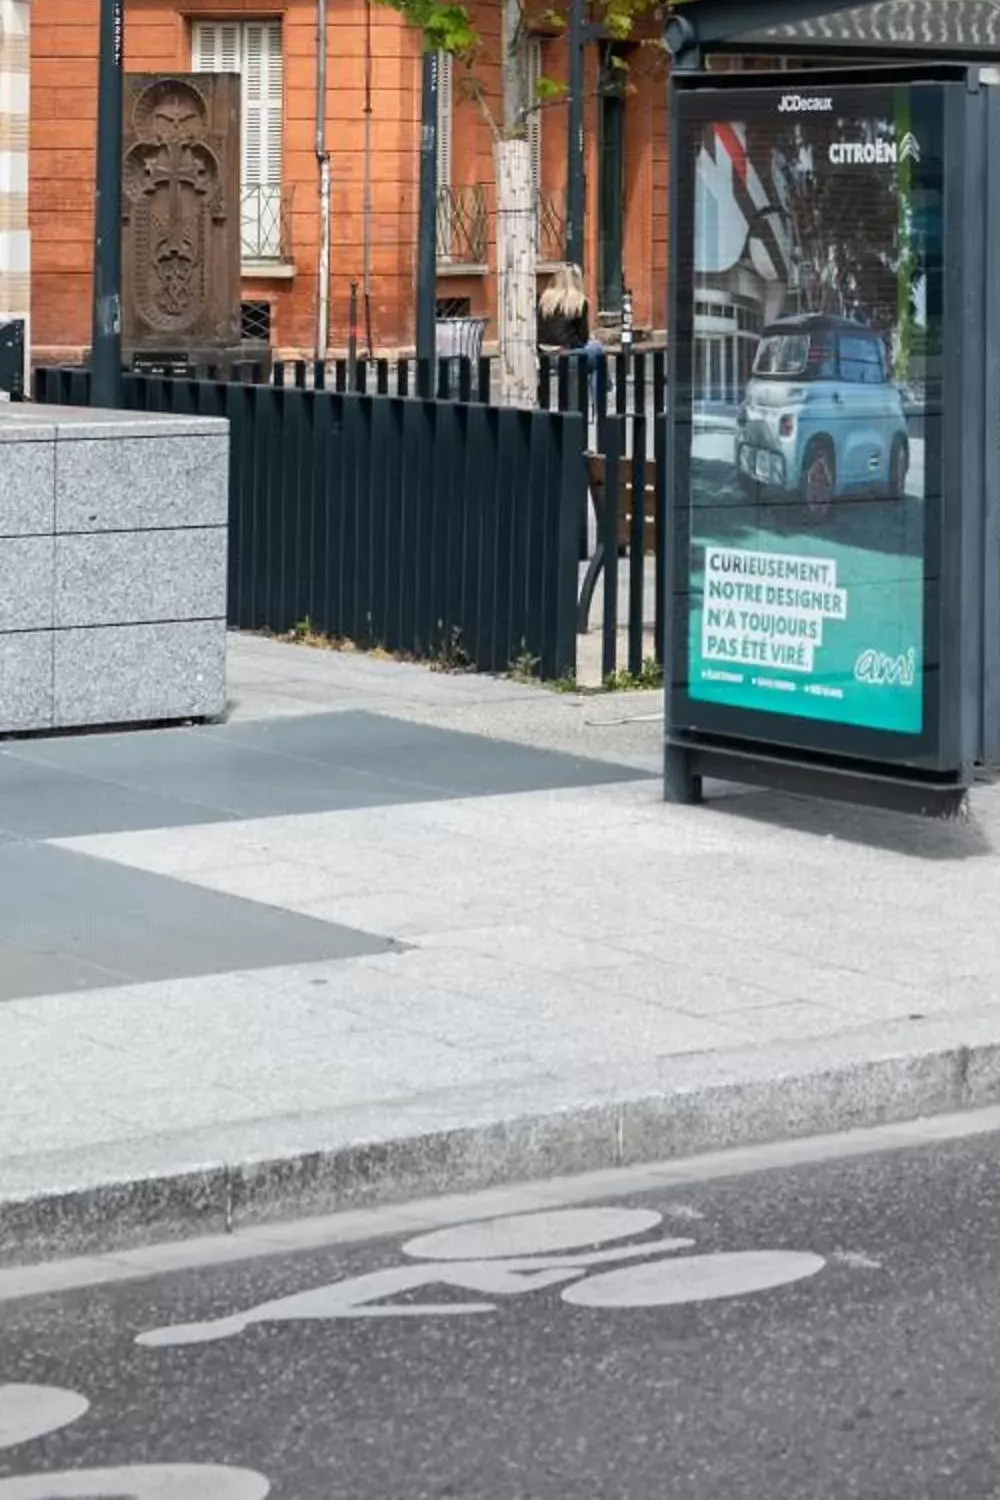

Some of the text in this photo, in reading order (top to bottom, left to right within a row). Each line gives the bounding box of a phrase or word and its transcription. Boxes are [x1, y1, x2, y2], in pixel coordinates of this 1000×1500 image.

[777, 95, 833, 112] JCDecaux
[829, 137, 898, 164] CITROËN
[709, 553, 833, 587] CURIEUSEMENT,
[708, 580, 843, 614] NOTRE DESIGNER
[707, 607, 818, 640] N'A TOUJOURS
[707, 635, 738, 657] PAS
[742, 636, 769, 661] ÉTÉ
[854, 647, 915, 687] ami
